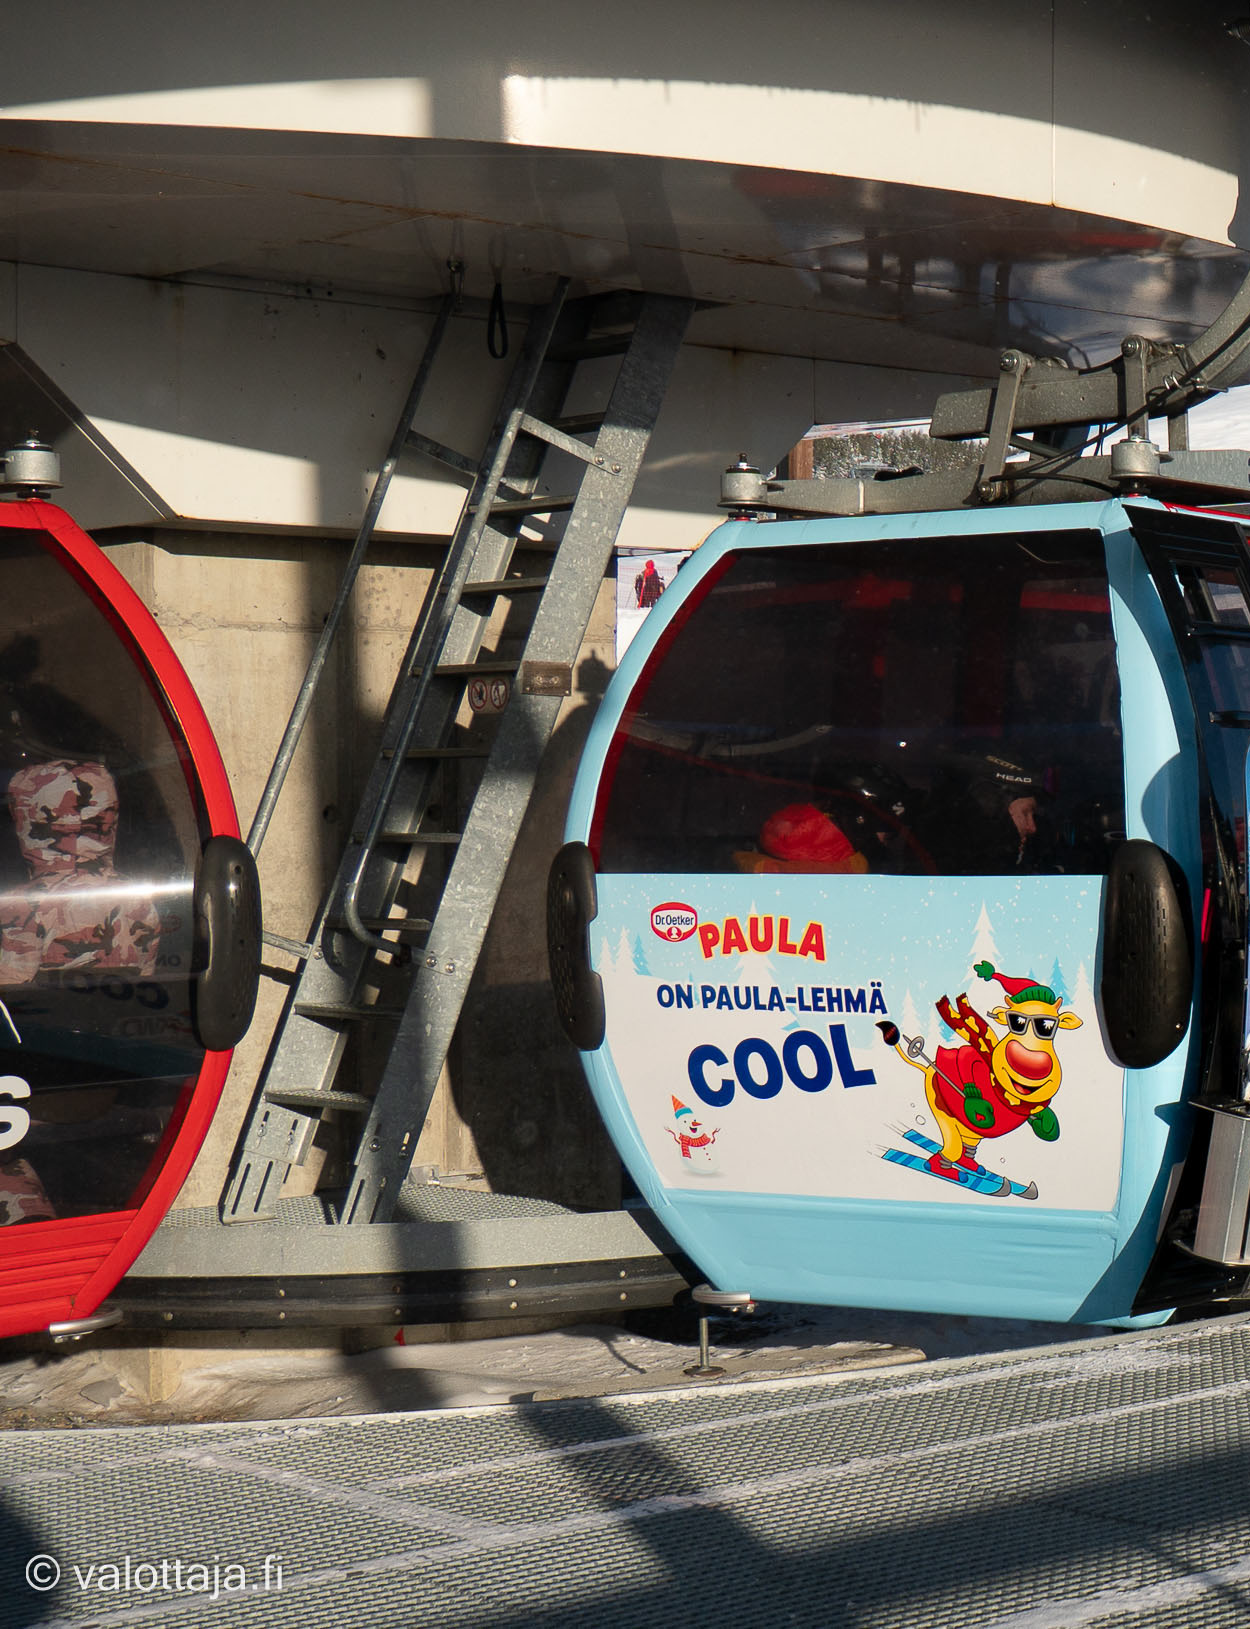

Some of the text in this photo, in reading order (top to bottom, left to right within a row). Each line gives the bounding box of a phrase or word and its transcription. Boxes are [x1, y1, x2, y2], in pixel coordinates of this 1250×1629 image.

[996, 773, 1032, 783] HEAD
[699, 916, 826, 961] PAULA
[657, 981, 888, 1015] ON PAULA-LEHMÄ
[688, 1023, 876, 1107] COOL
